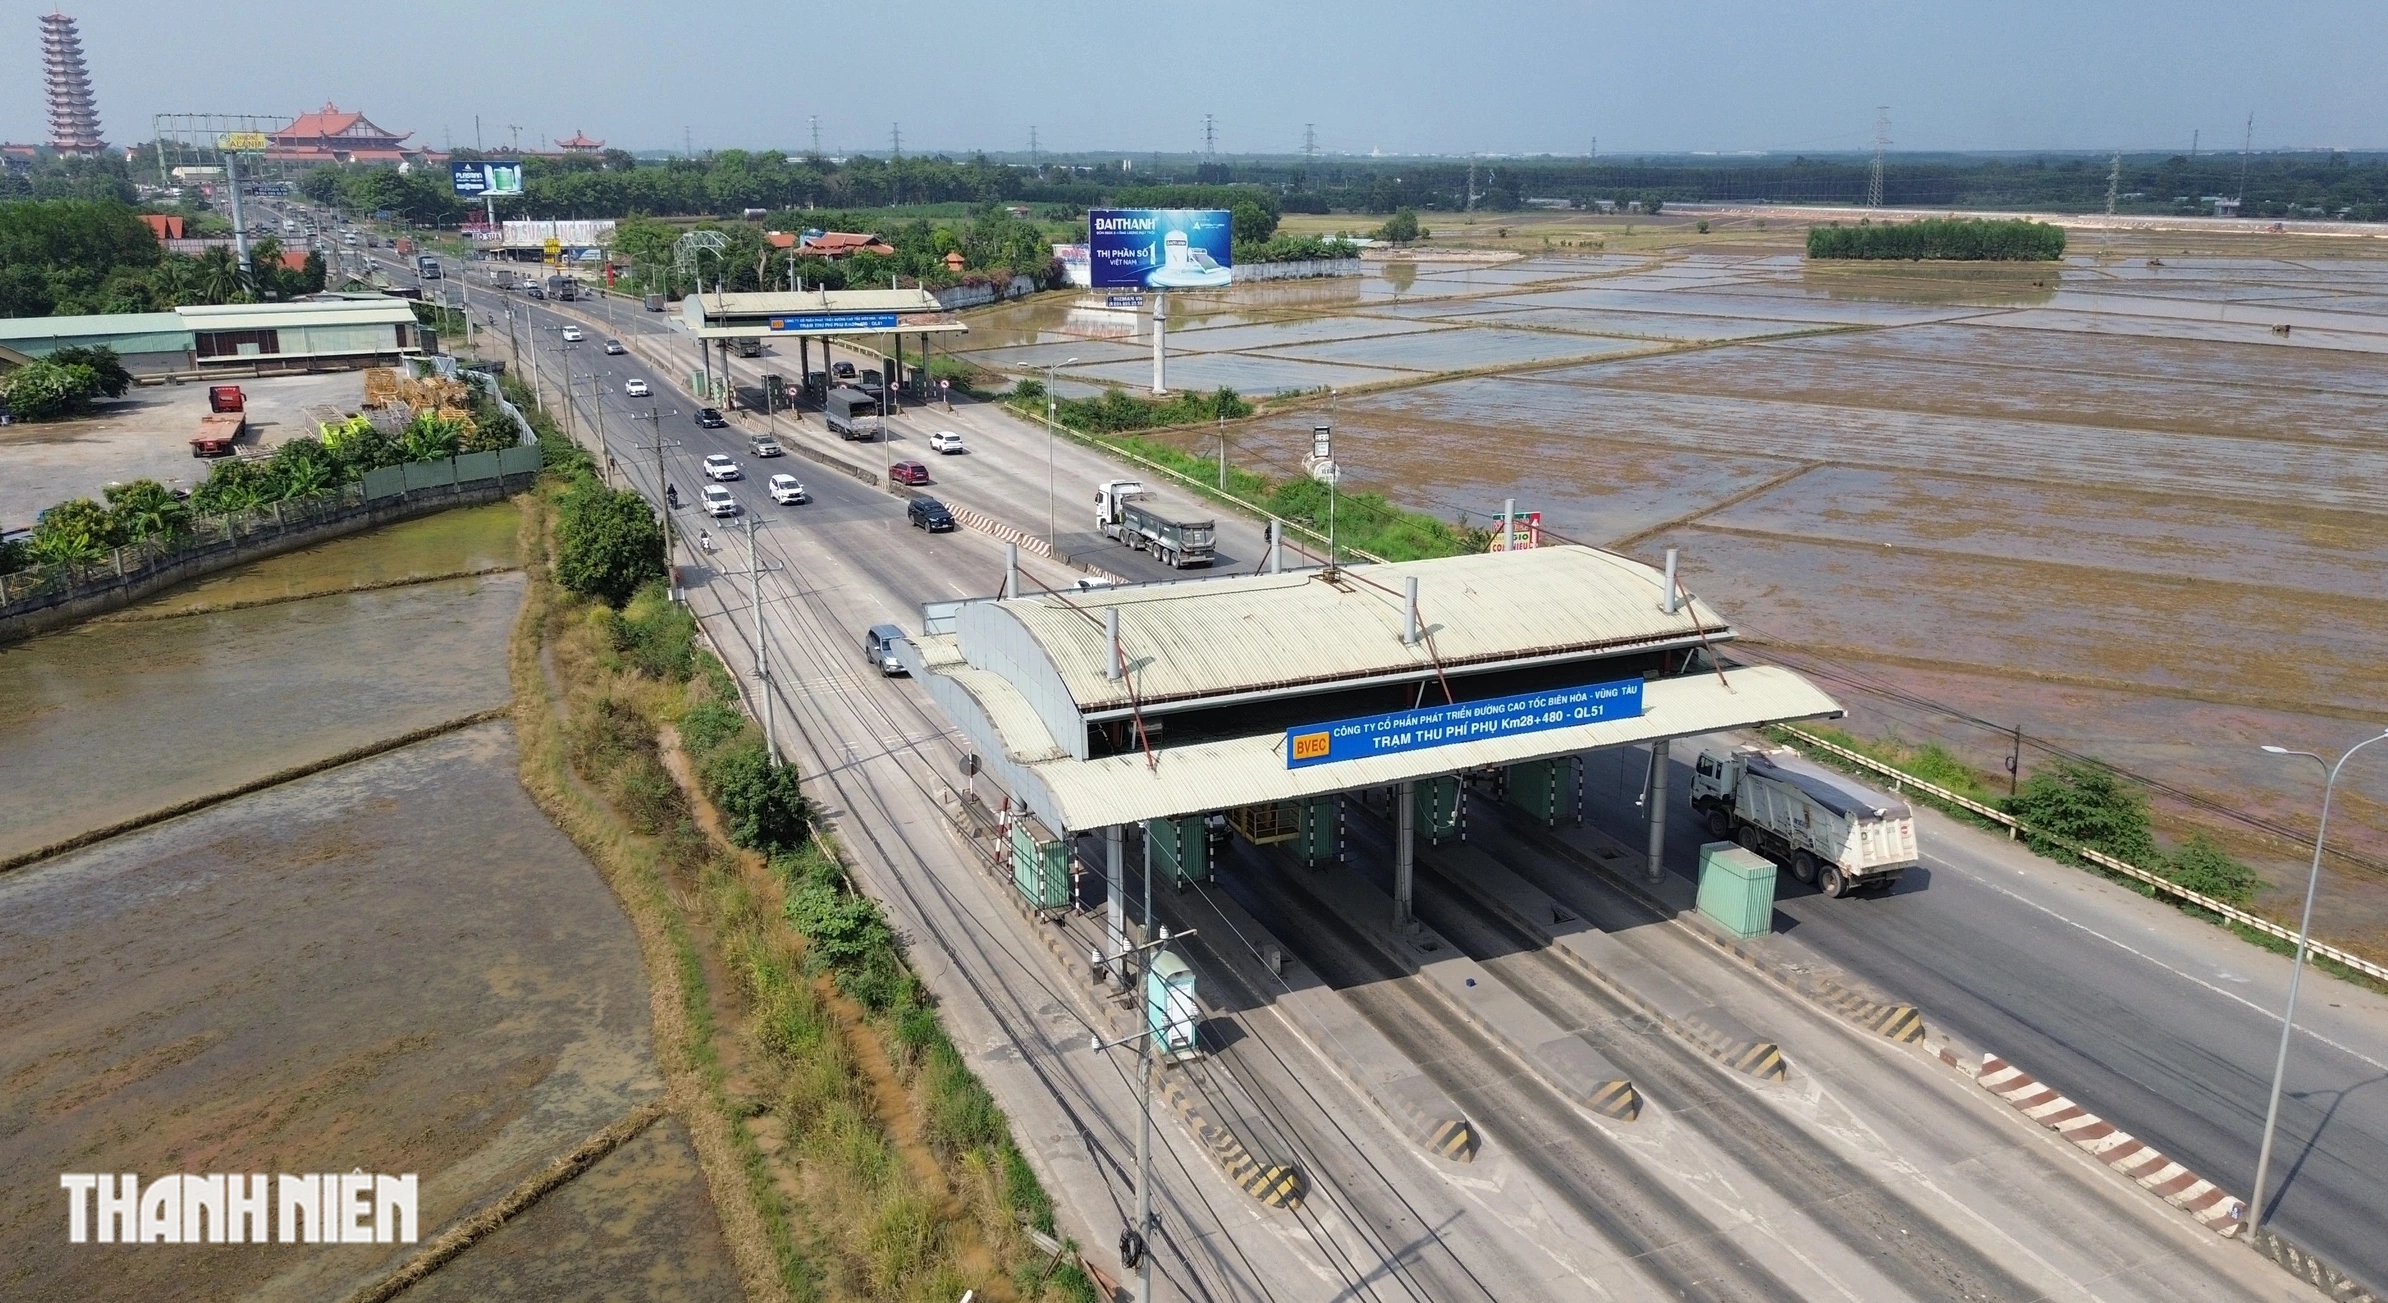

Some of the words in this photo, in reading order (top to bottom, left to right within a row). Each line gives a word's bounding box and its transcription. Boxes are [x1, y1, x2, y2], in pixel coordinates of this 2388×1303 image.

[1333, 725, 1361, 737] CÔNG
[1363, 723, 1376, 732] TY
[1379, 716, 1391, 731] CỔ
[1393, 713, 1419, 728] PHẦN
[1419, 710, 1444, 725] PHÁT
[1446, 706, 1472, 721] TRIỂN
[1474, 702, 1506, 718] ĐƯỜNG
[1507, 701, 1526, 711] CAO
[1528, 695, 1547, 709] TỐC
[1547, 695, 1569, 706] BIÊN
[1570, 691, 1588, 704] HÒA
[1594, 688, 1618, 700] VŨNG
[1621, 685, 1638, 696] TÀU
[1372, 734, 1411, 749] TRẠM
[1415, 730, 1443, 743] THU
[1445, 724, 1468, 738] PHÍ
[1471, 720, 1498, 734] PHỤ
[1501, 714, 1563, 730] Km28+480
[1573, 705, 1604, 719] QL51
[1297, 738, 1326, 755] BVEC
